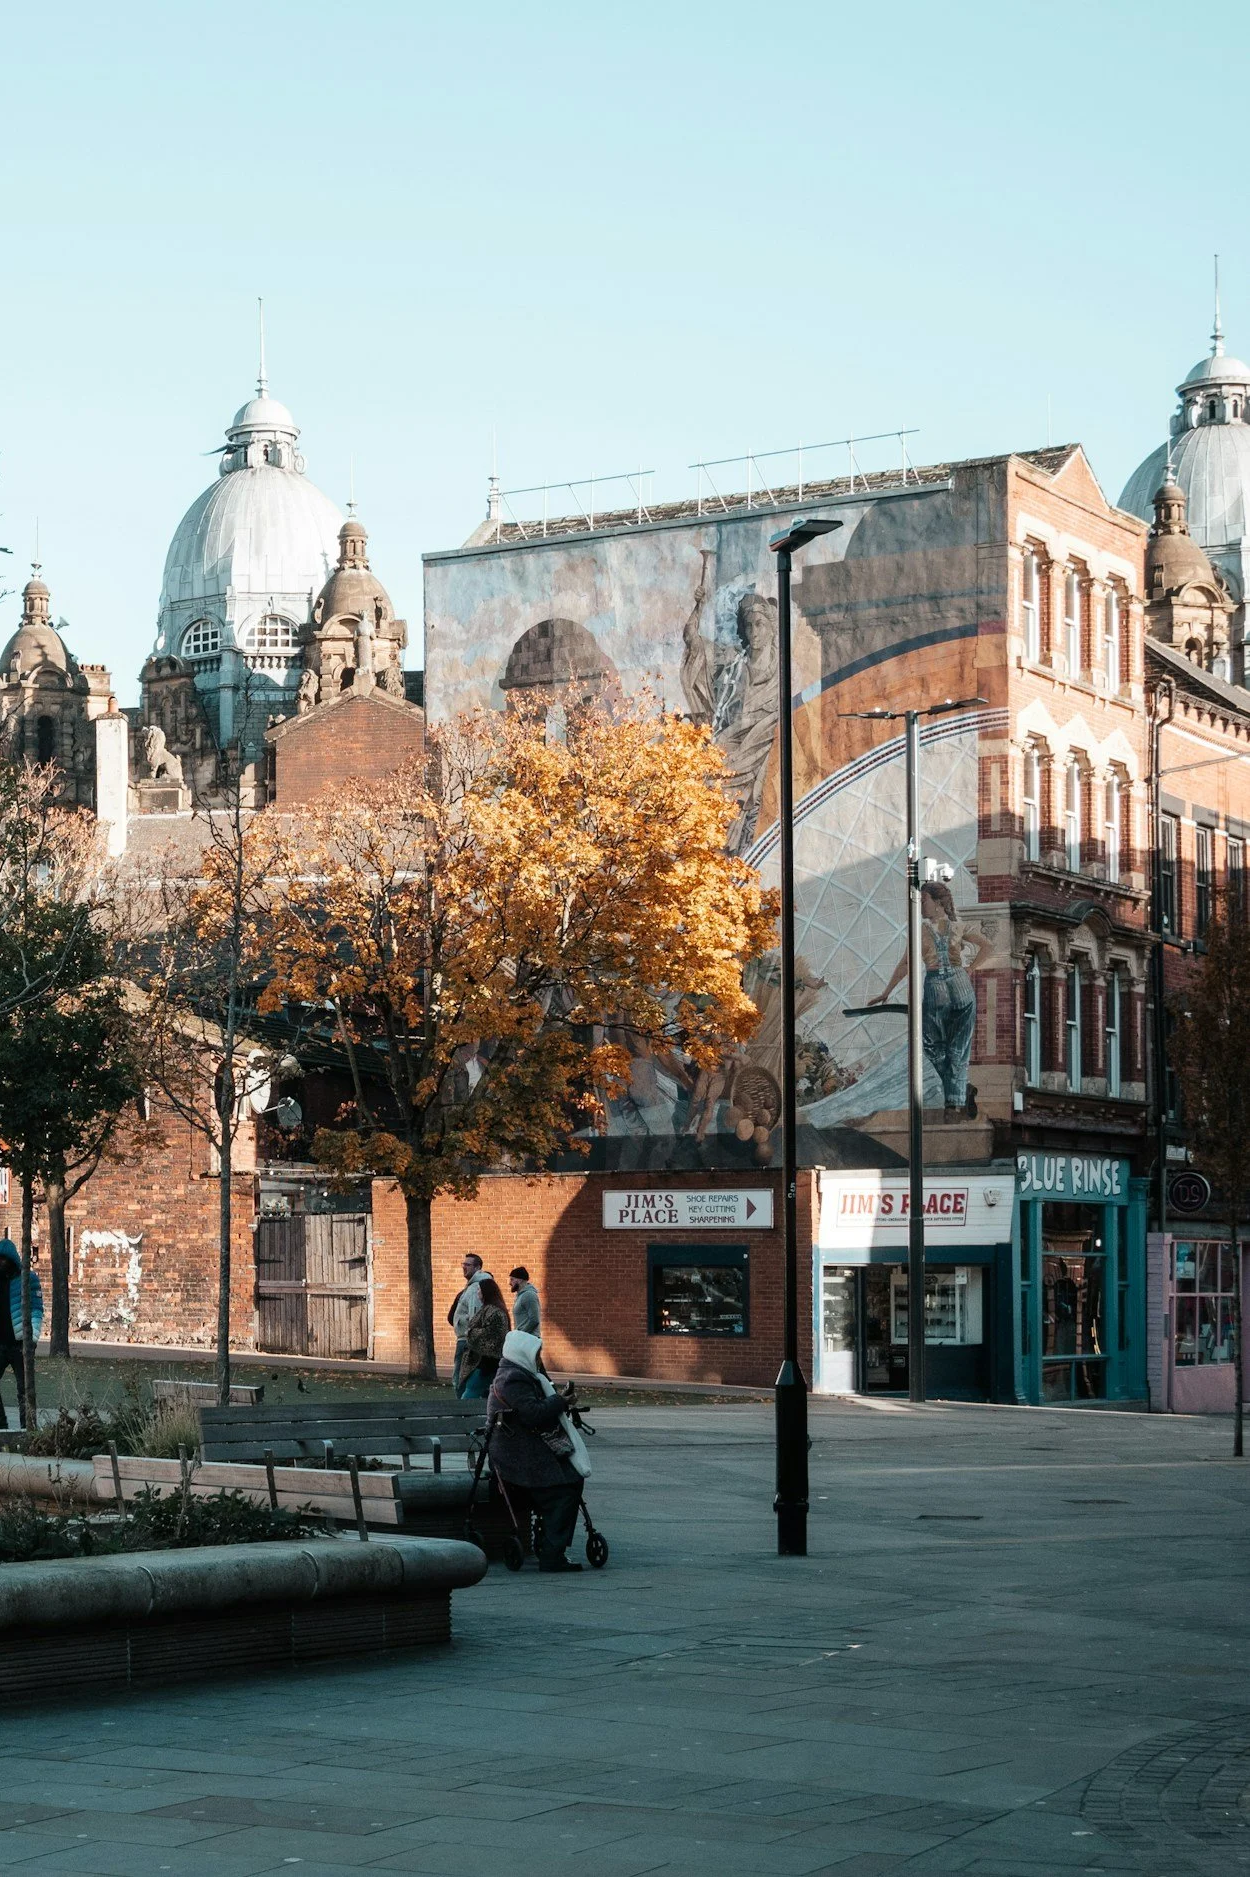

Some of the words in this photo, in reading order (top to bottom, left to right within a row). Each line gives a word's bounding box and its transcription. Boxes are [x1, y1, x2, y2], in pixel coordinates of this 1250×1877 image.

[1017, 1155, 1066, 1192] BLUE
[1070, 1157, 1121, 1196] RINSE
[625, 1194, 674, 1208] JIM'S
[840, 1193, 894, 1215] JIM'S
[705, 1205, 736, 1213] CUTTING
[618, 1210, 679, 1223] PLACE
